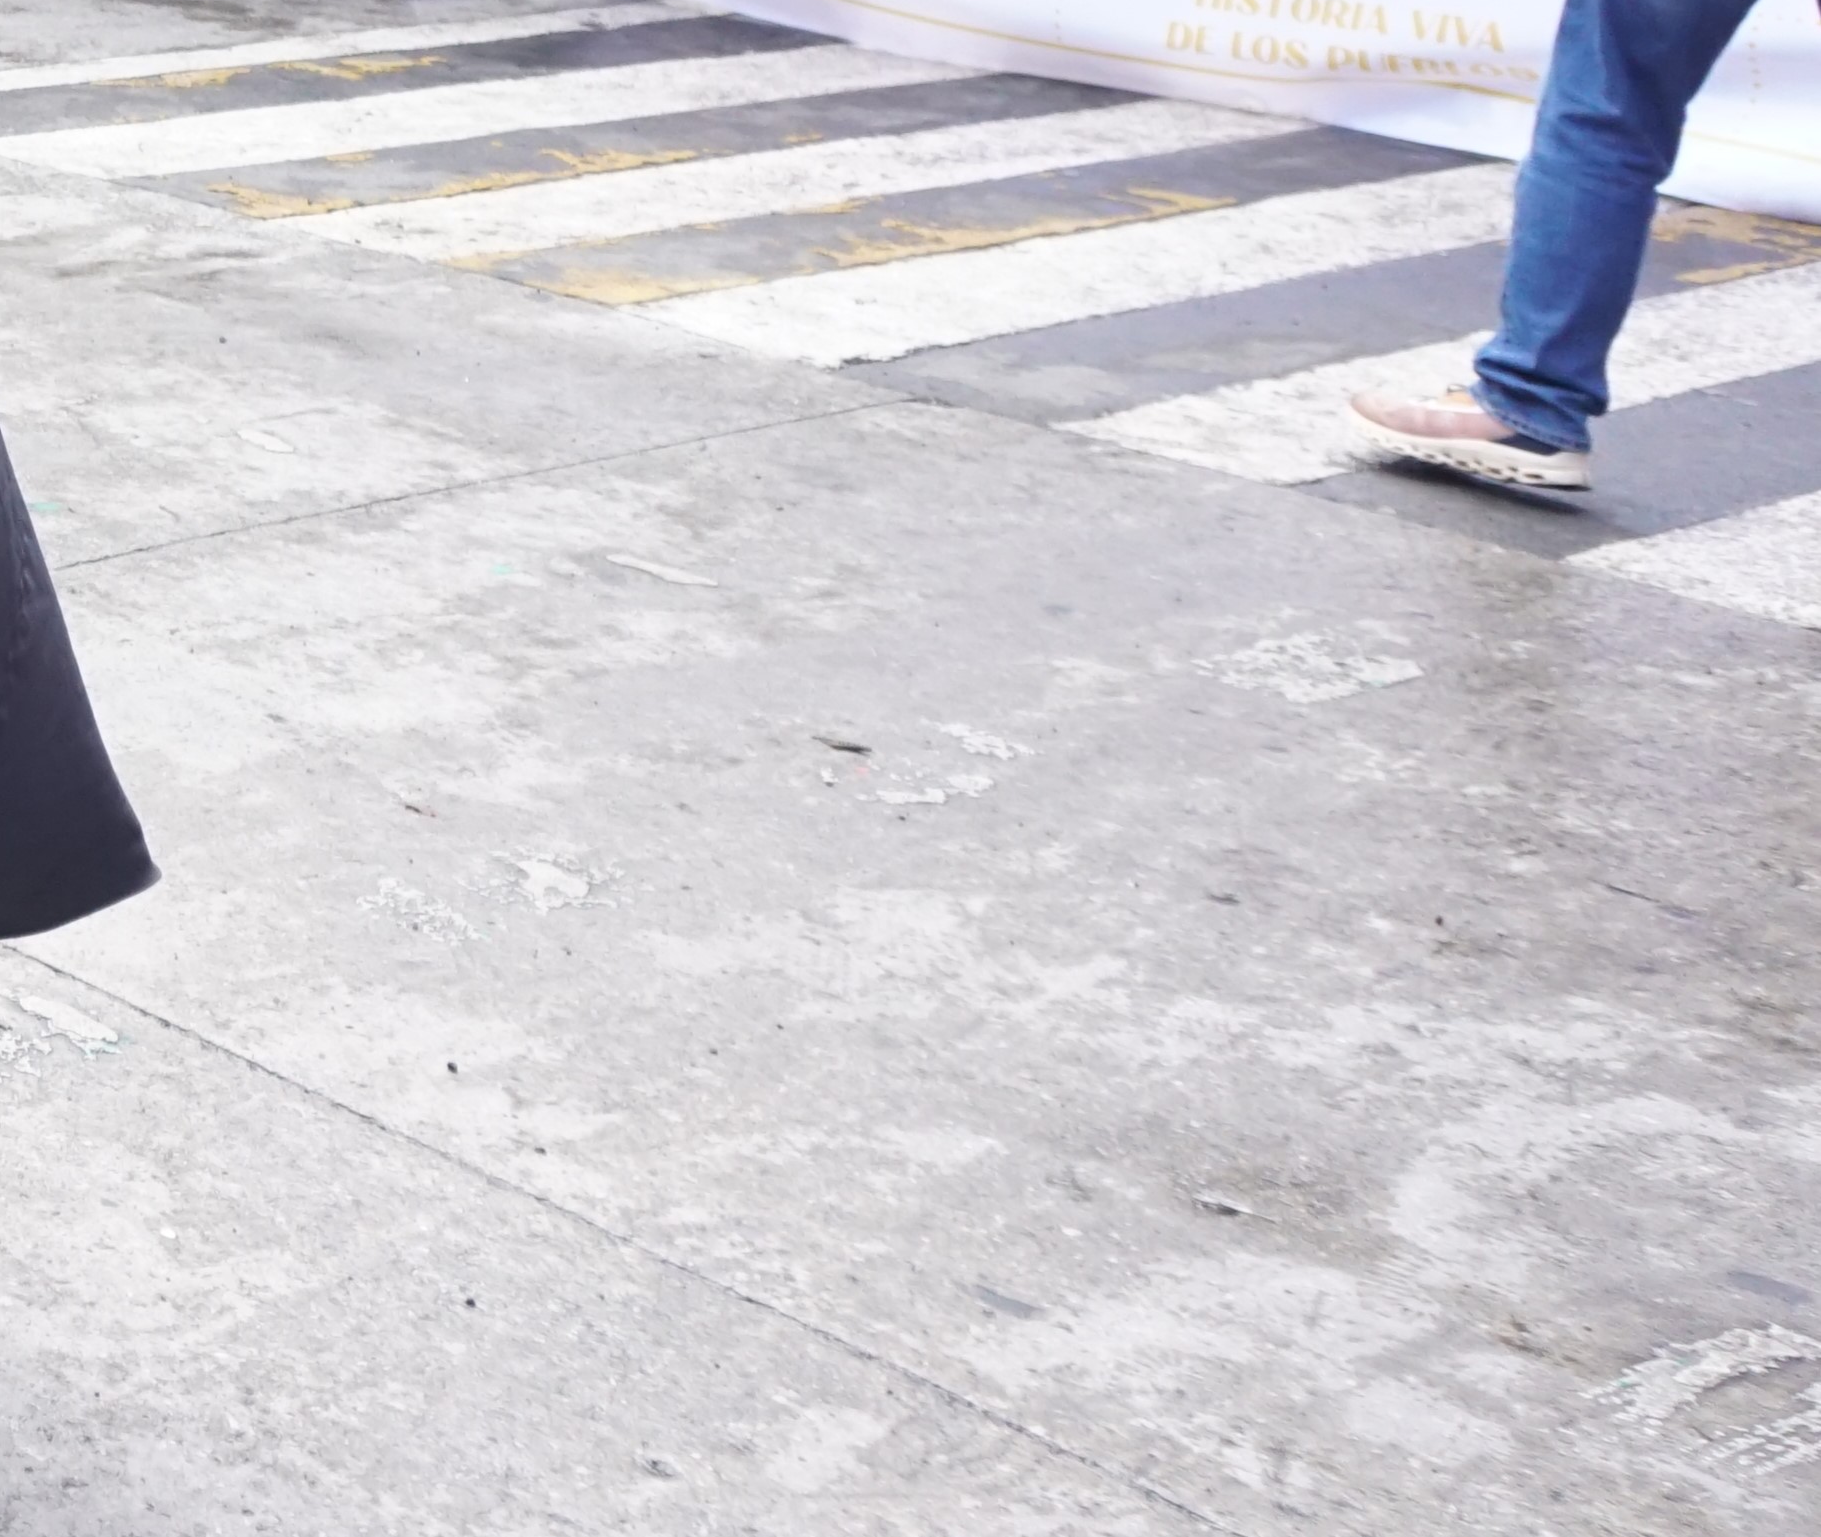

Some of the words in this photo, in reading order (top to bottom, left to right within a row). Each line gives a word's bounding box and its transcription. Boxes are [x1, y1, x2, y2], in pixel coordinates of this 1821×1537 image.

[1165, 20, 1215, 56] DE
[1230, 30, 1310, 71] LOS
[1412, 9, 1505, 54] VIVA
